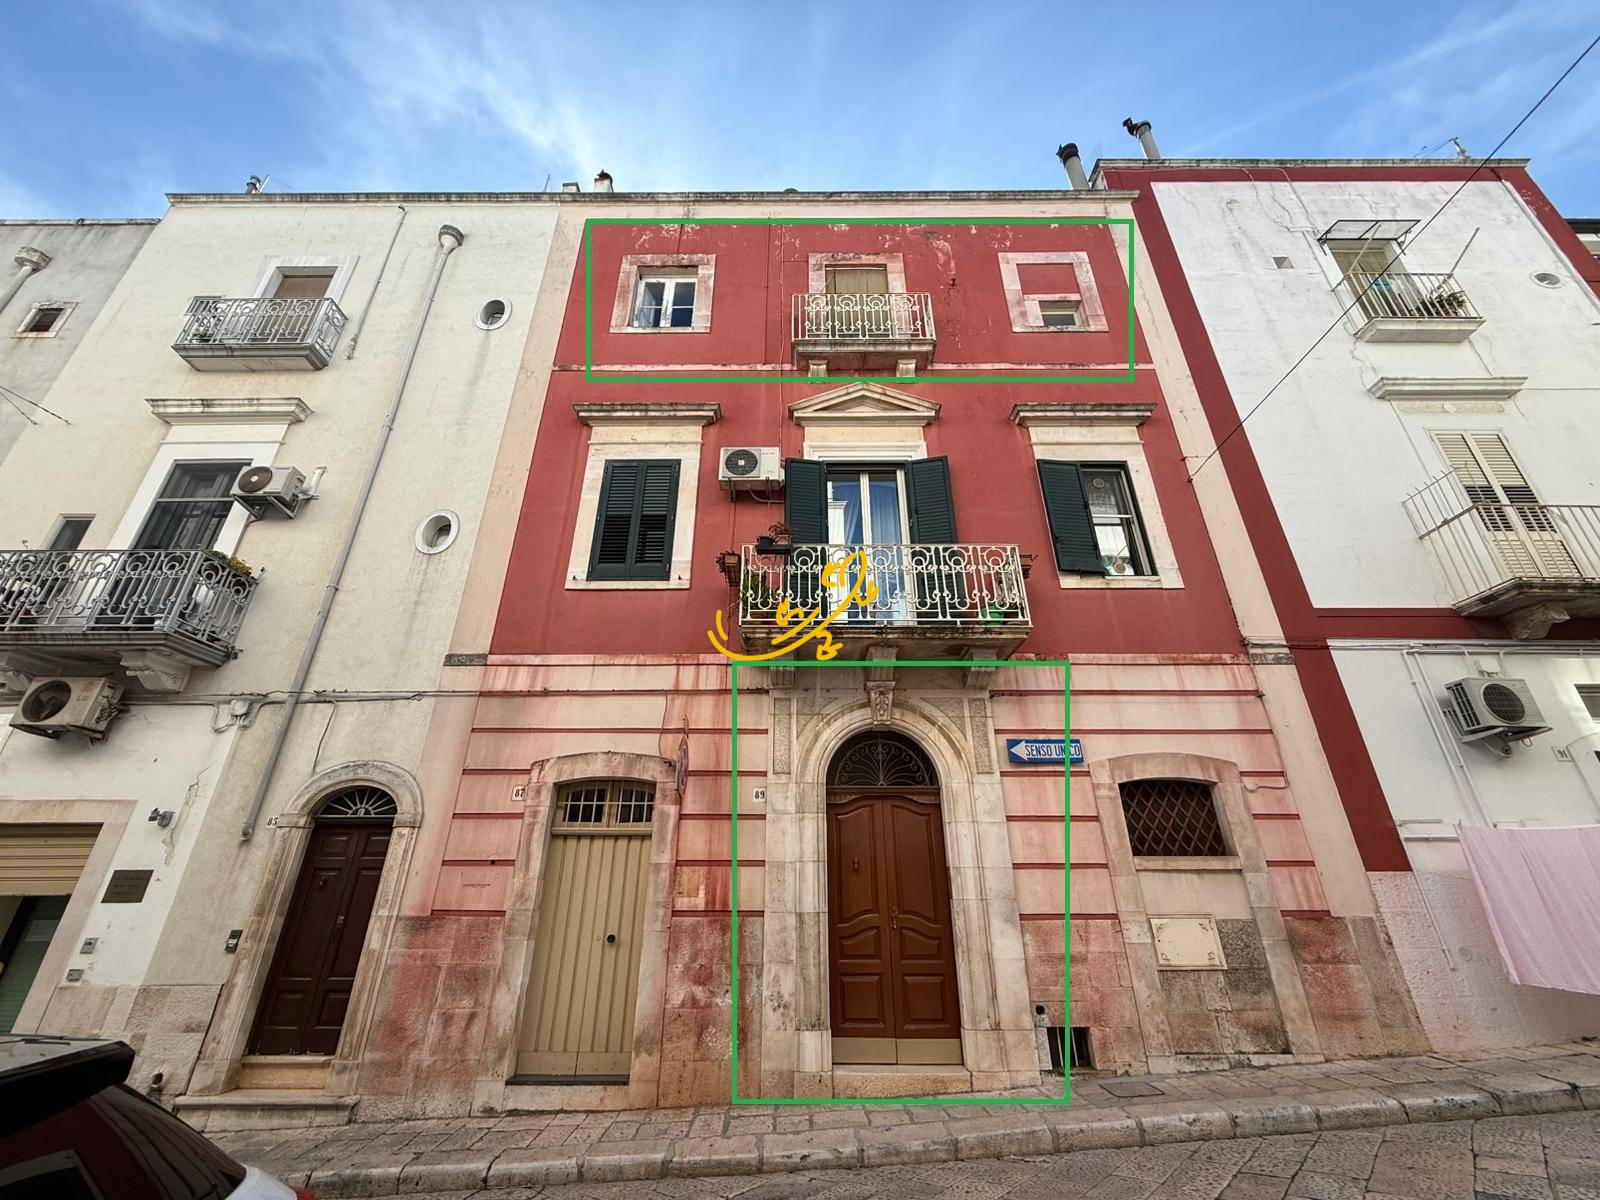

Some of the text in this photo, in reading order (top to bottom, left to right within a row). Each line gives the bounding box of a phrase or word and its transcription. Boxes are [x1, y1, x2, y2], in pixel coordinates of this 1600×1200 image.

[1025, 744, 1081, 757] SENSO UNCO
[1557, 749, 1568, 758] 91
[515, 788, 526, 798] 87
[754, 790, 765, 800] 89
[266, 816, 279, 826] 85
